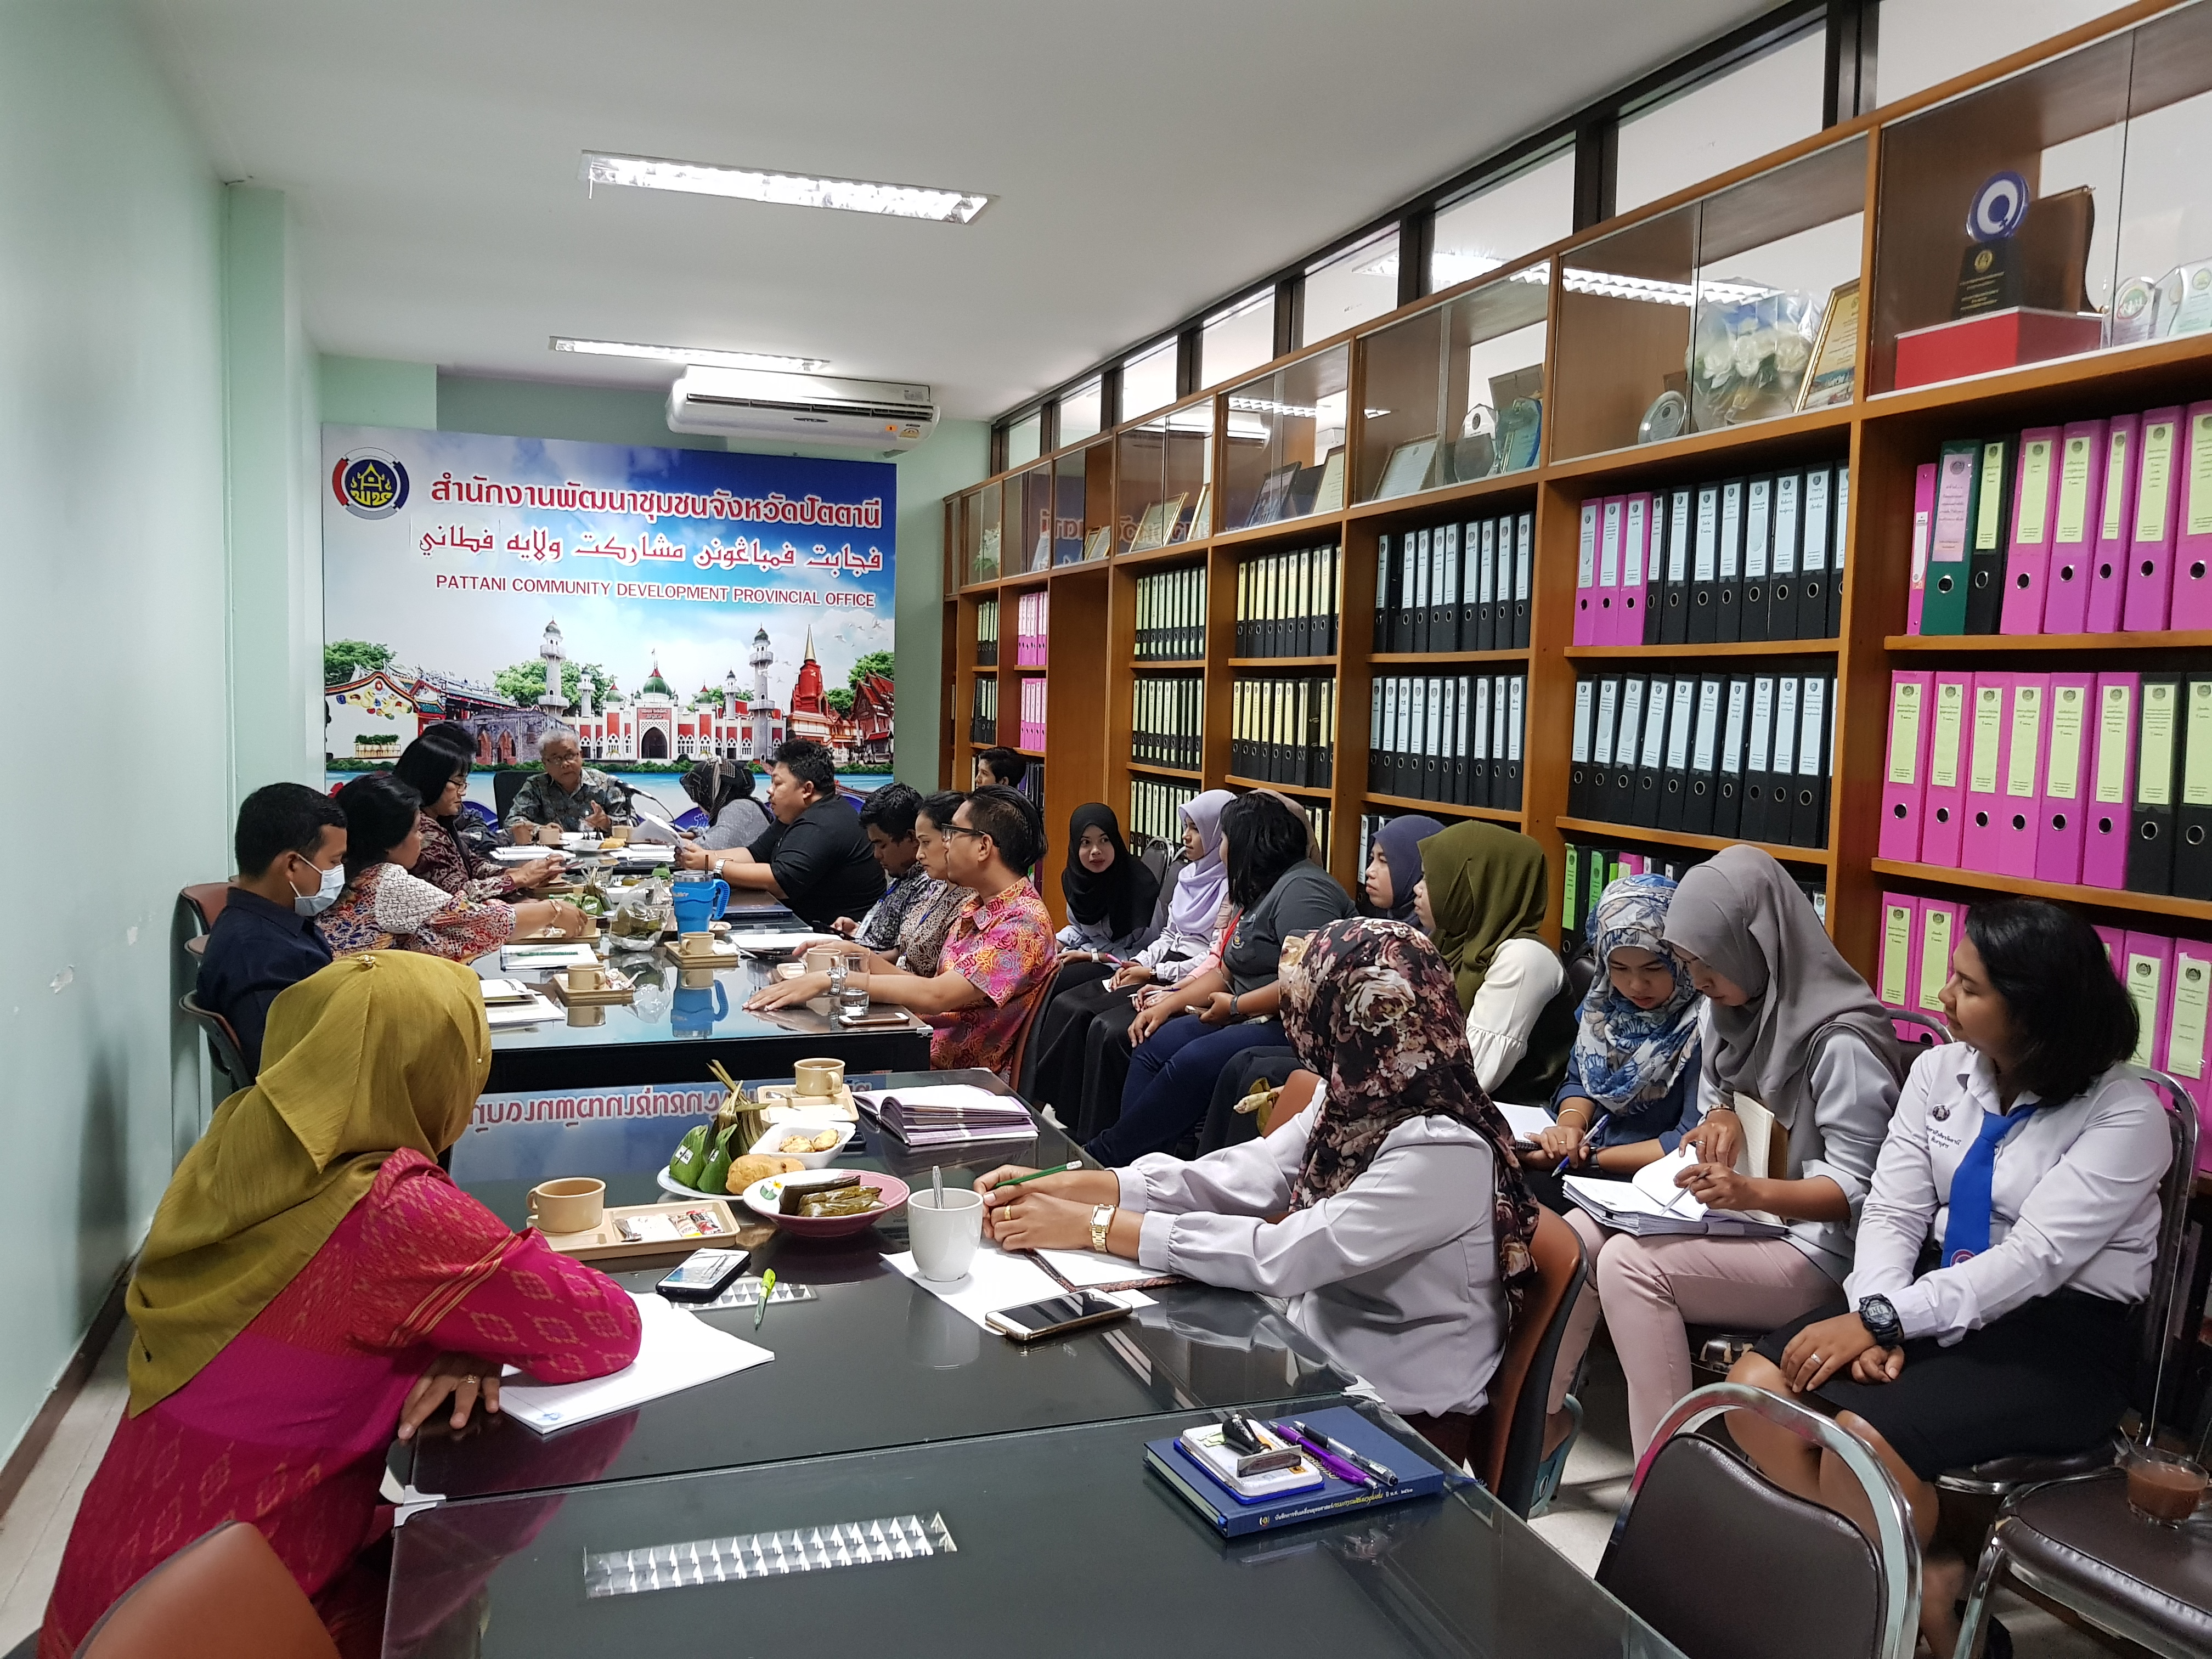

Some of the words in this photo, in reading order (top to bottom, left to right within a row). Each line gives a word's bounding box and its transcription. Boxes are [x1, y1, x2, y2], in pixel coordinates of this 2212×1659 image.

[431, 472, 881, 527] สำนักงานพัฒนาชุมชนจังหวัดปัตตานี
[806, 544, 881, 576] فجابت
[437, 575, 506, 591] PATTANI
[512, 578, 611, 596] COMMUNITY
[617, 583, 729, 601] DEVELOPMENT
[733, 588, 820, 604] PROVINCIAL
[826, 592, 876, 607] OFFICE
